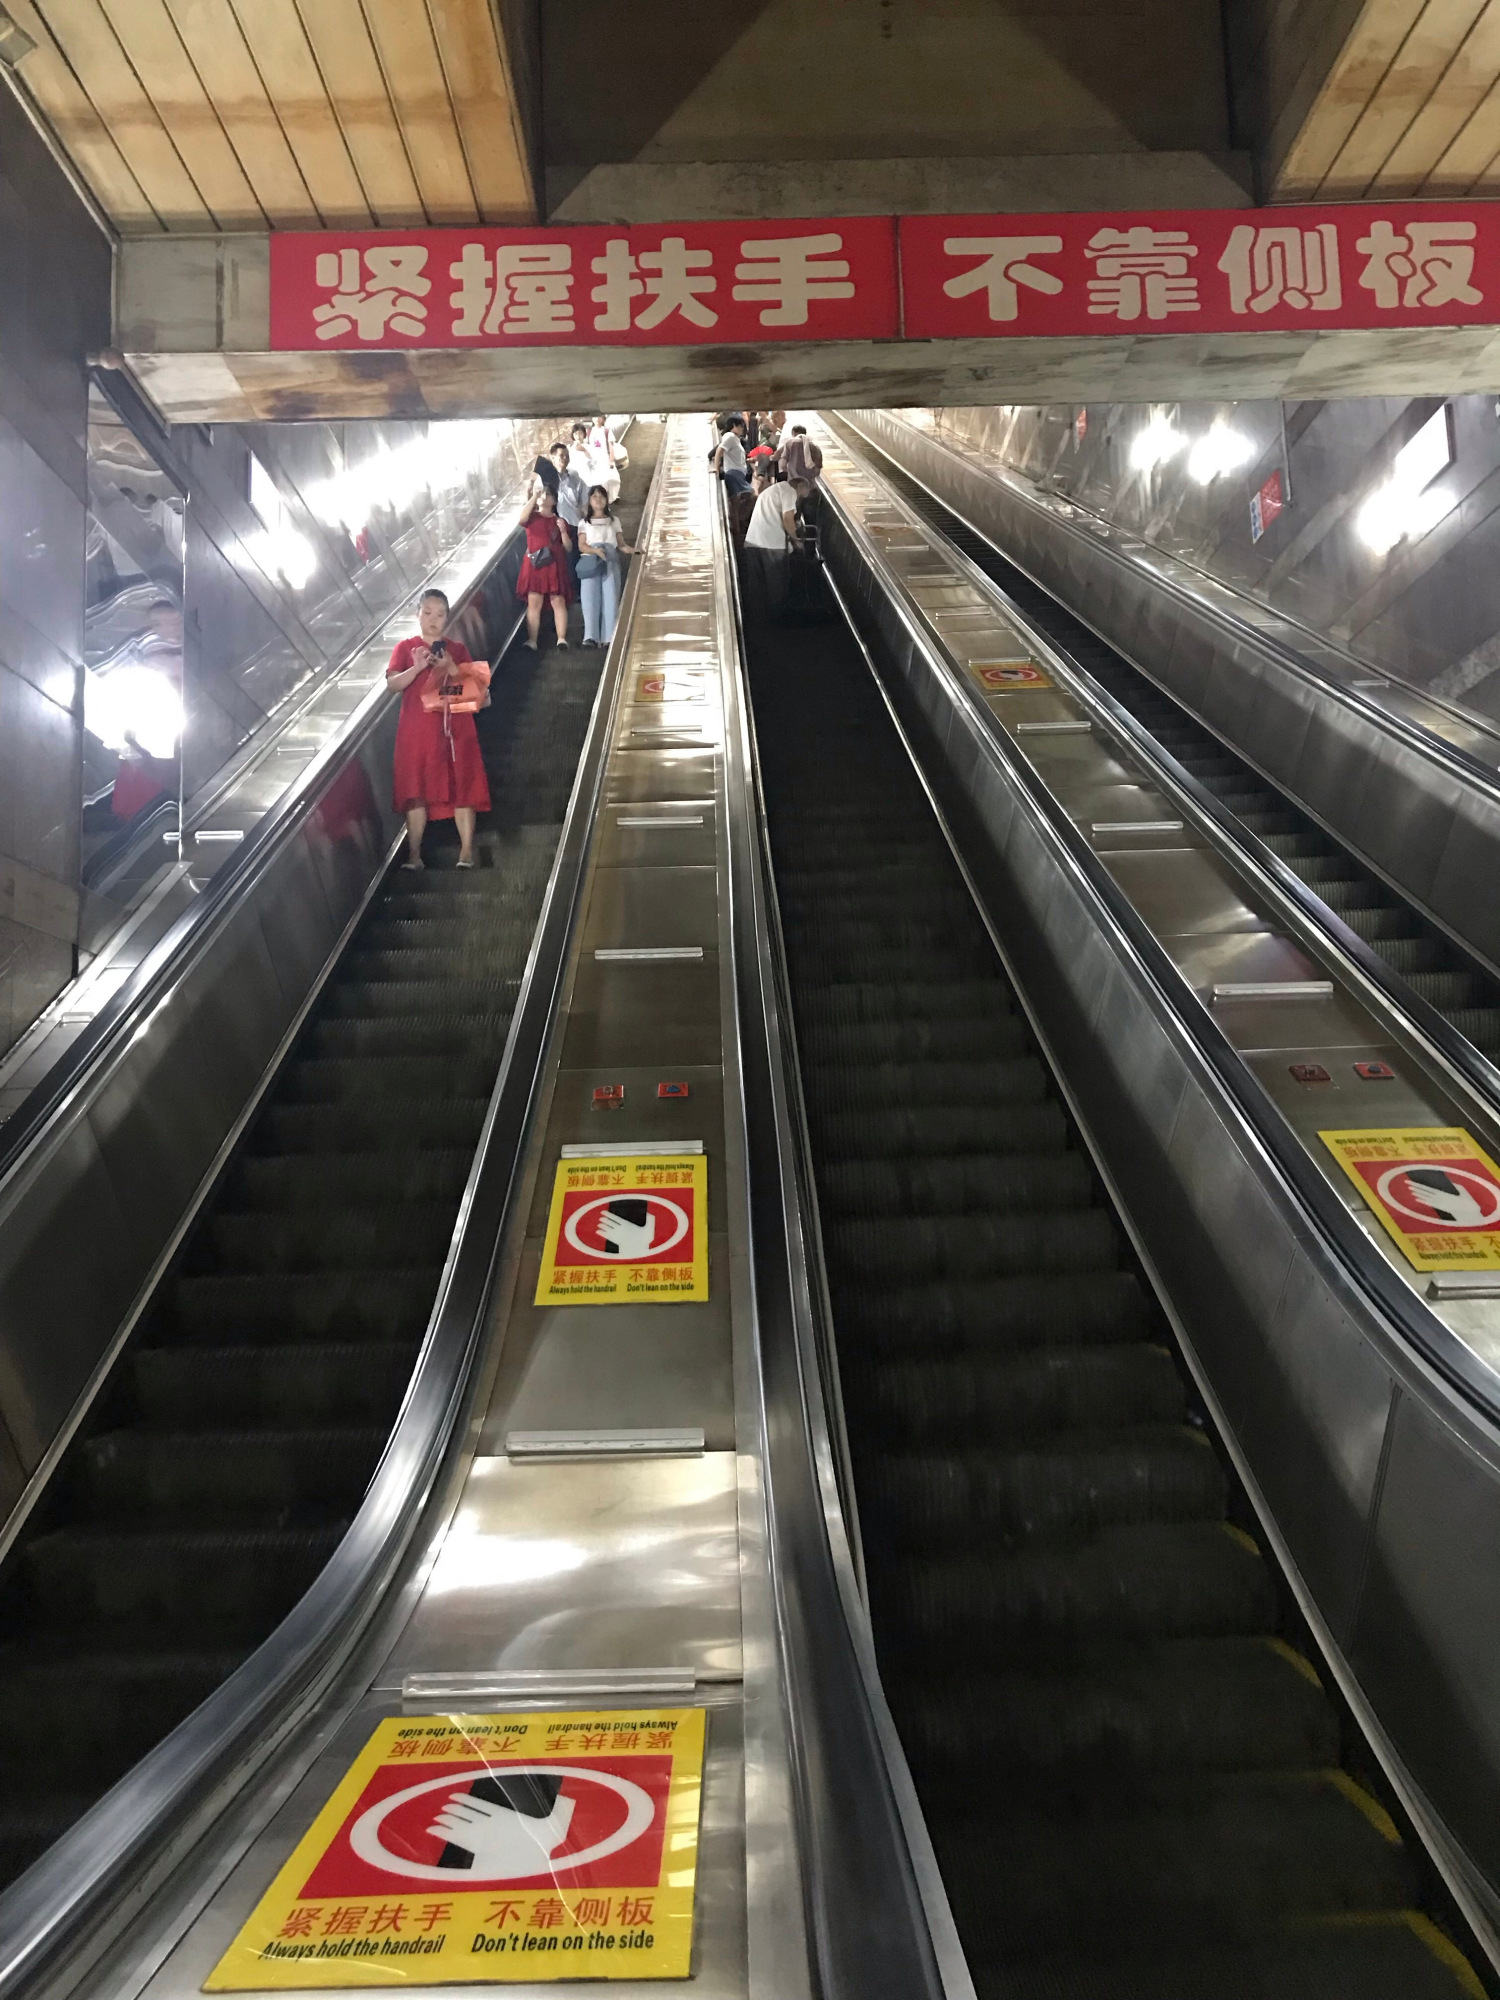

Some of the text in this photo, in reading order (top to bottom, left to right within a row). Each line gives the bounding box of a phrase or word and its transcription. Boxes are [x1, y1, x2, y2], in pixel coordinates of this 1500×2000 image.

[312, 220, 1483, 341] 紧握扶手 不靠侧板
[567, 1173, 625, 1187] 不靠侧板
[636, 1171, 693, 1184] 紧握扶手
[552, 1266, 693, 1285] 紧握扶手 不靠侧板
[549, 1285, 569, 1295] Always
[584, 1284, 593, 1292] the
[627, 1283, 644, 1292] Don't
[646, 1283, 659, 1291] lean
[669, 1283, 680, 1291] the
[681, 1282, 694, 1290] side
[398, 1728, 424, 1739] side
[426, 1728, 446, 1737] the
[467, 1726, 491, 1736] lean
[494, 1725, 528, 1735] Don't
[548, 1720, 678, 1734] Always hold the handrail
[387, 1736, 521, 1758] 不靠侧板
[545, 1732, 674, 1751] 紧握扶手
[276, 1896, 655, 1939] 紧握扶手 不靠侧板
[258, 1934, 446, 1962] Always hold the handrail
[471, 1929, 654, 1953] Don't lean on the side
